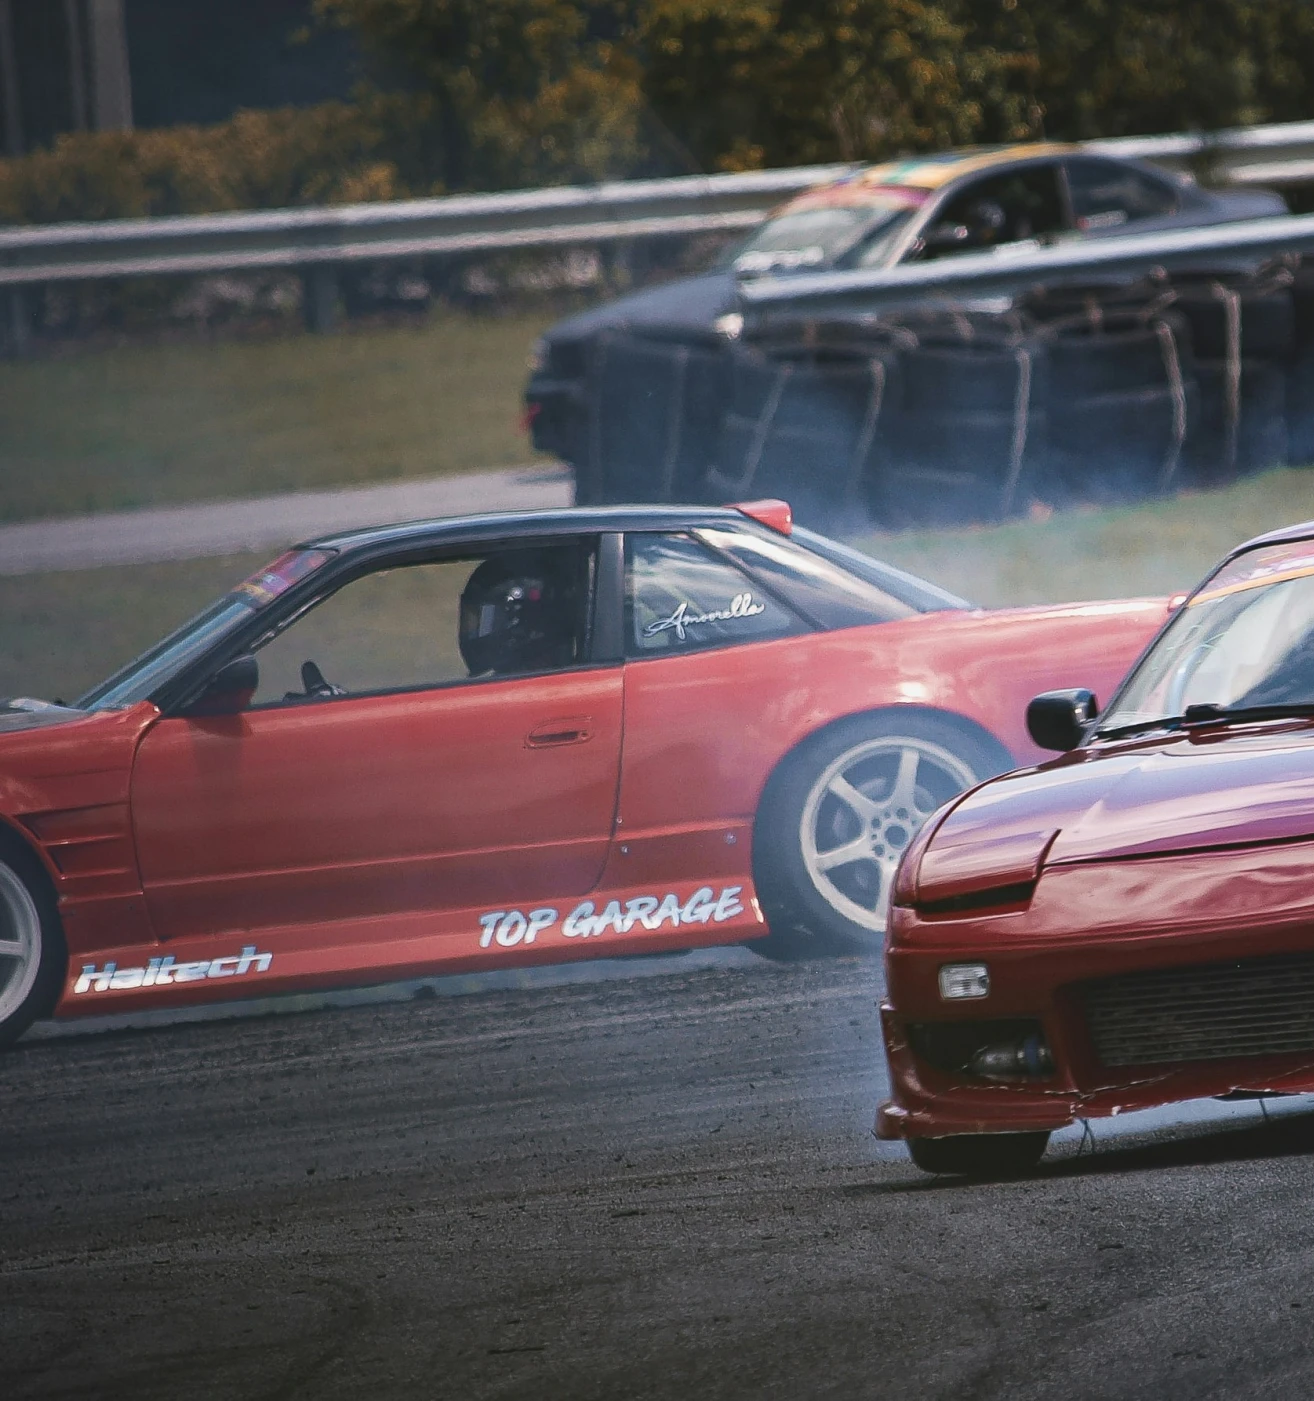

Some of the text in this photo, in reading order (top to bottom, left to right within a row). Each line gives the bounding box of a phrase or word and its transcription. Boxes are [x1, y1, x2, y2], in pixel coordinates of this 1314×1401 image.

[479, 885, 744, 948] TOP GARAGE
[73, 945, 273, 994] Haltech
